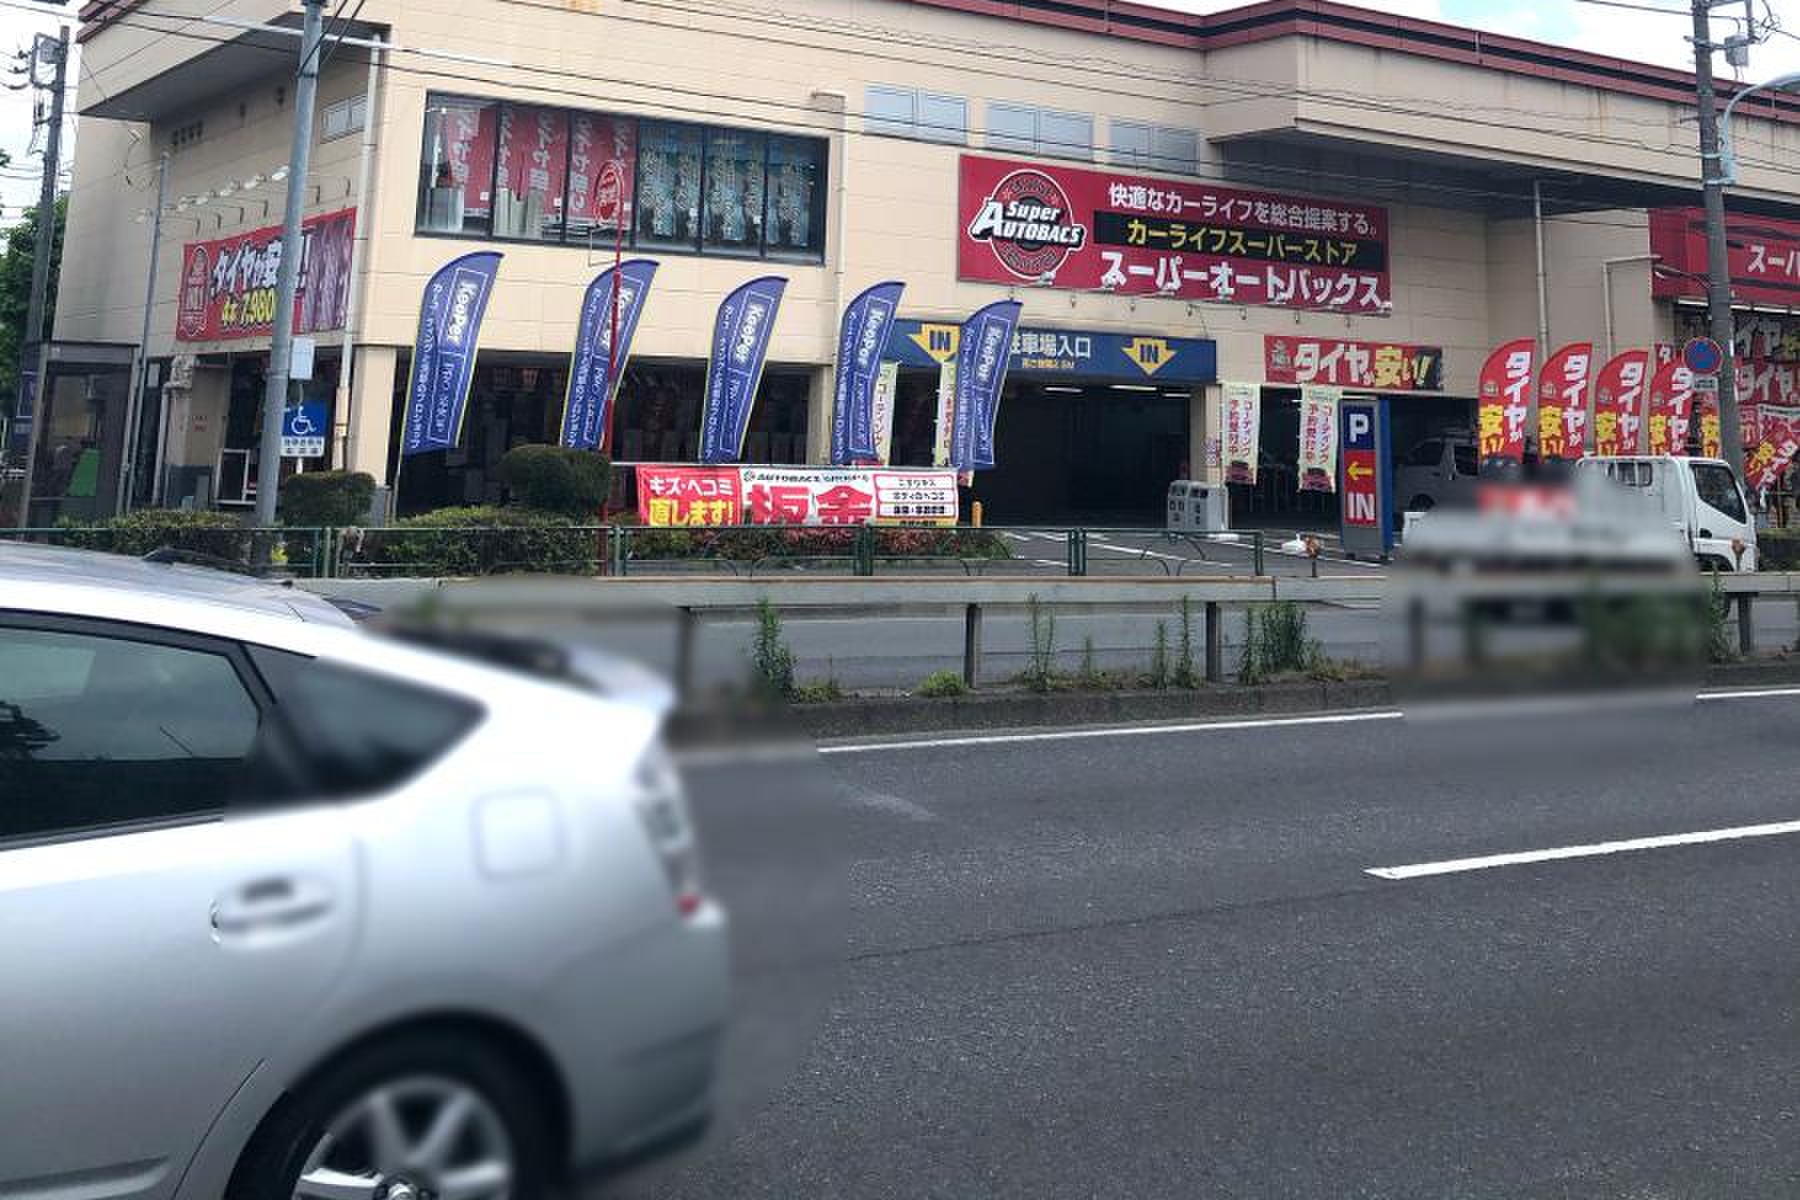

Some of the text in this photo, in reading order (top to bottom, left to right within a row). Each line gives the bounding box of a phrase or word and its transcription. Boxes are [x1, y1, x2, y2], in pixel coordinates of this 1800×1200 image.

[971, 201, 1082, 243] AUTOBACS
[1006, 200, 1061, 221] Super
[1127, 219, 1358, 265] カーライフスーパーストア
[1100, 251, 1380, 308] スーパーオートバックス
[1139, 345, 1159, 363] IN
[1349, 413, 1369, 443] P
[649, 475, 734, 497] キズ・ヘコミ
[649, 498, 734, 526] 直します!
[1347, 492, 1375, 520] IN
